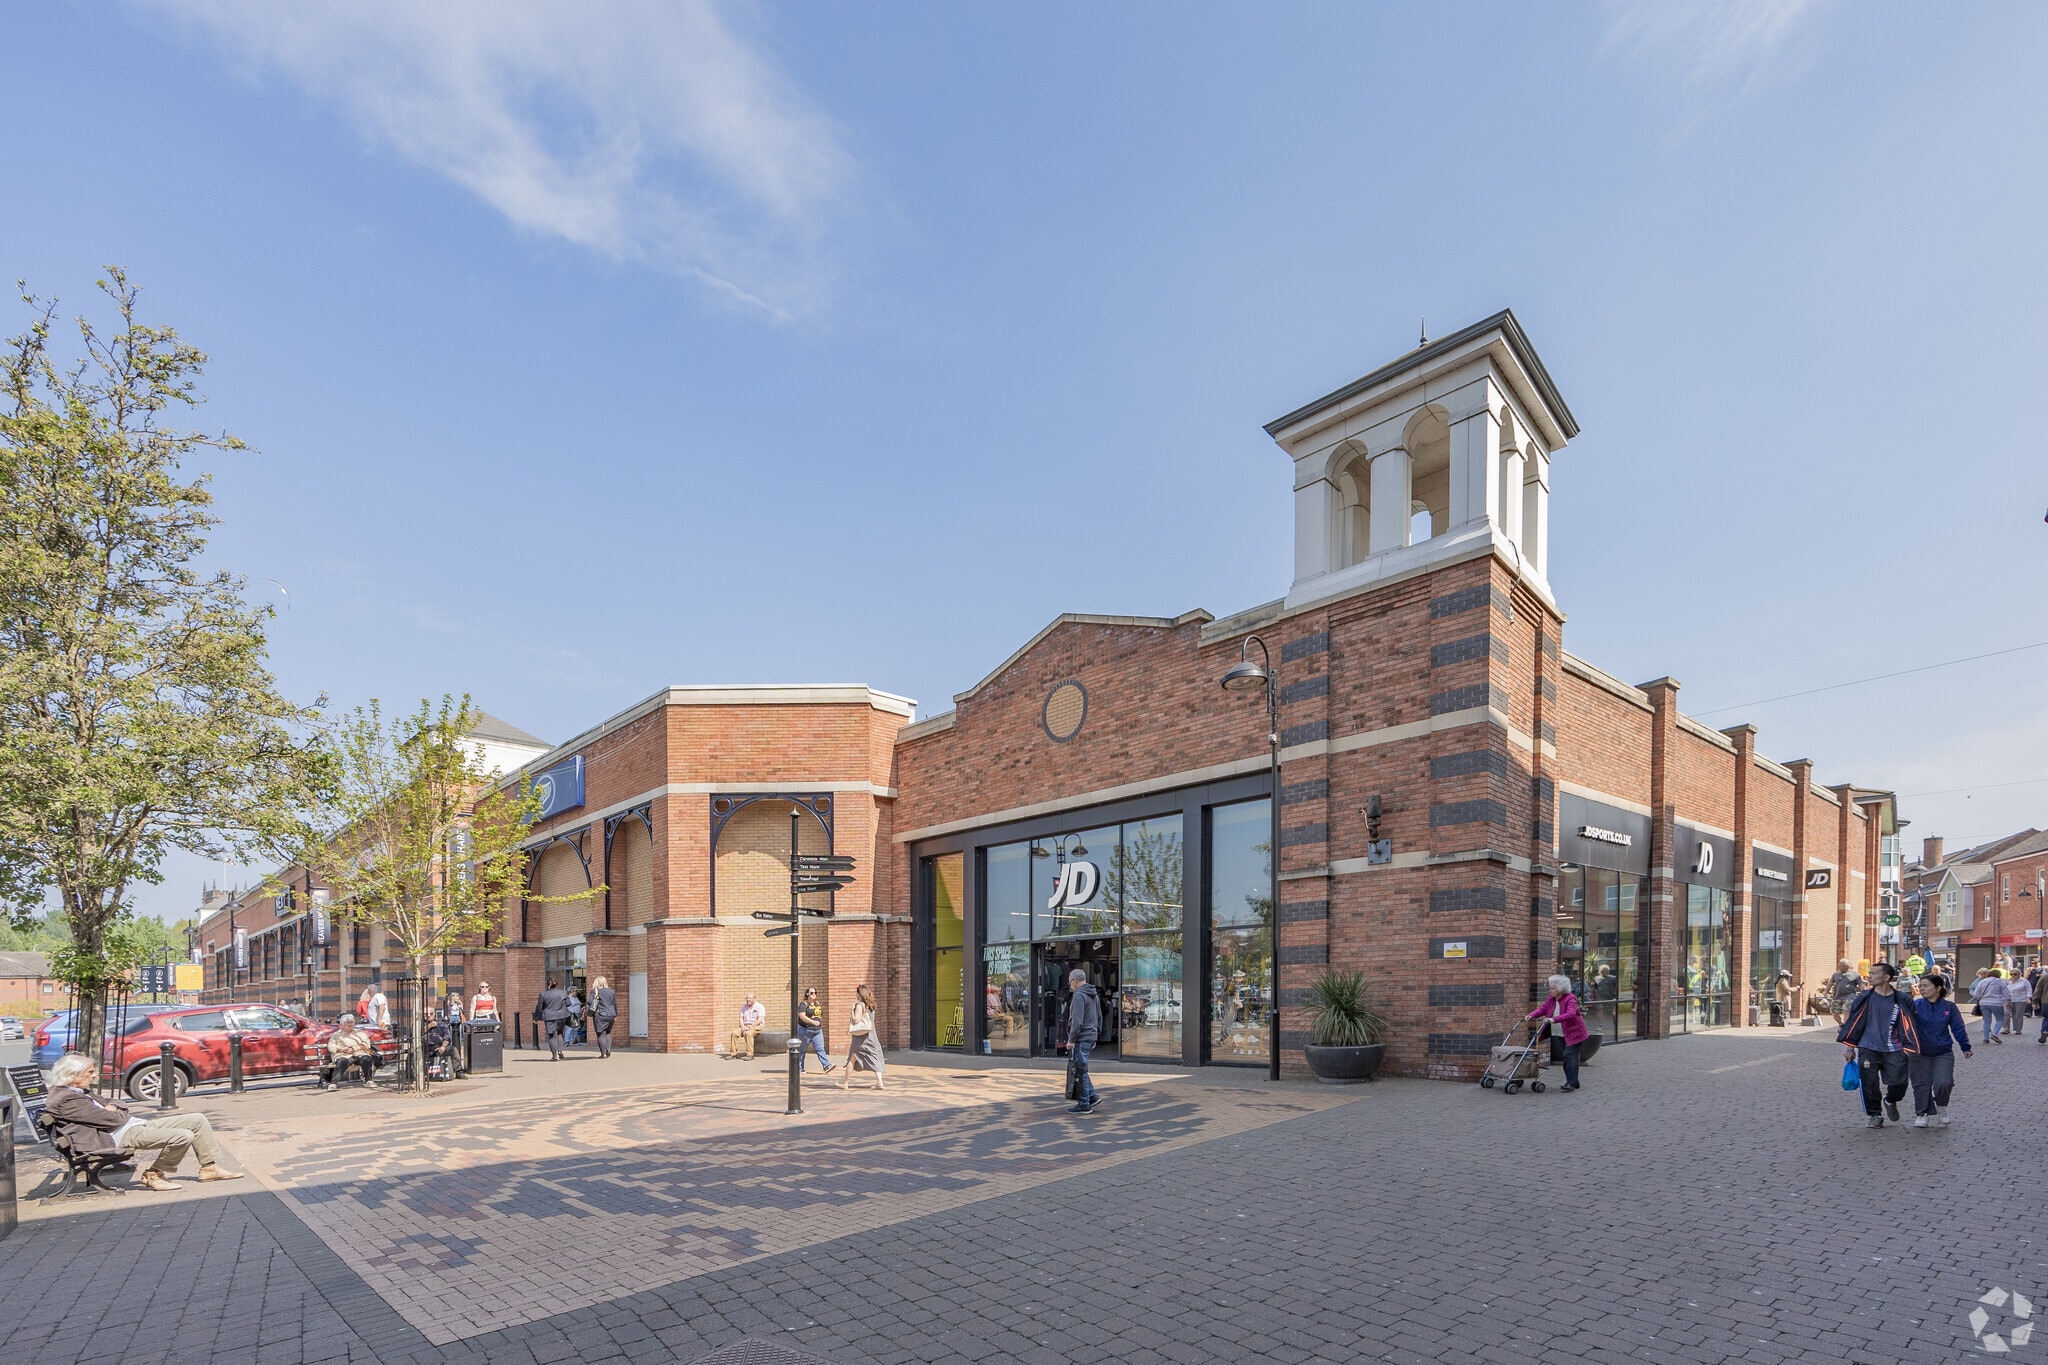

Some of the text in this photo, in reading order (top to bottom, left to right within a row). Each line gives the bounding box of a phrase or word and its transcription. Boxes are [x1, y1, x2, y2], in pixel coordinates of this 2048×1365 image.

[1584, 825, 1632, 846] JDSPORTS.CO.UK
[1697, 842, 1714, 874] JD
[1048, 861, 1099, 909] JD
[1807, 872, 1830, 886] JD
[983, 945, 1012, 961] THIS SPACE
[988, 960, 1012, 975] IS YOURS
